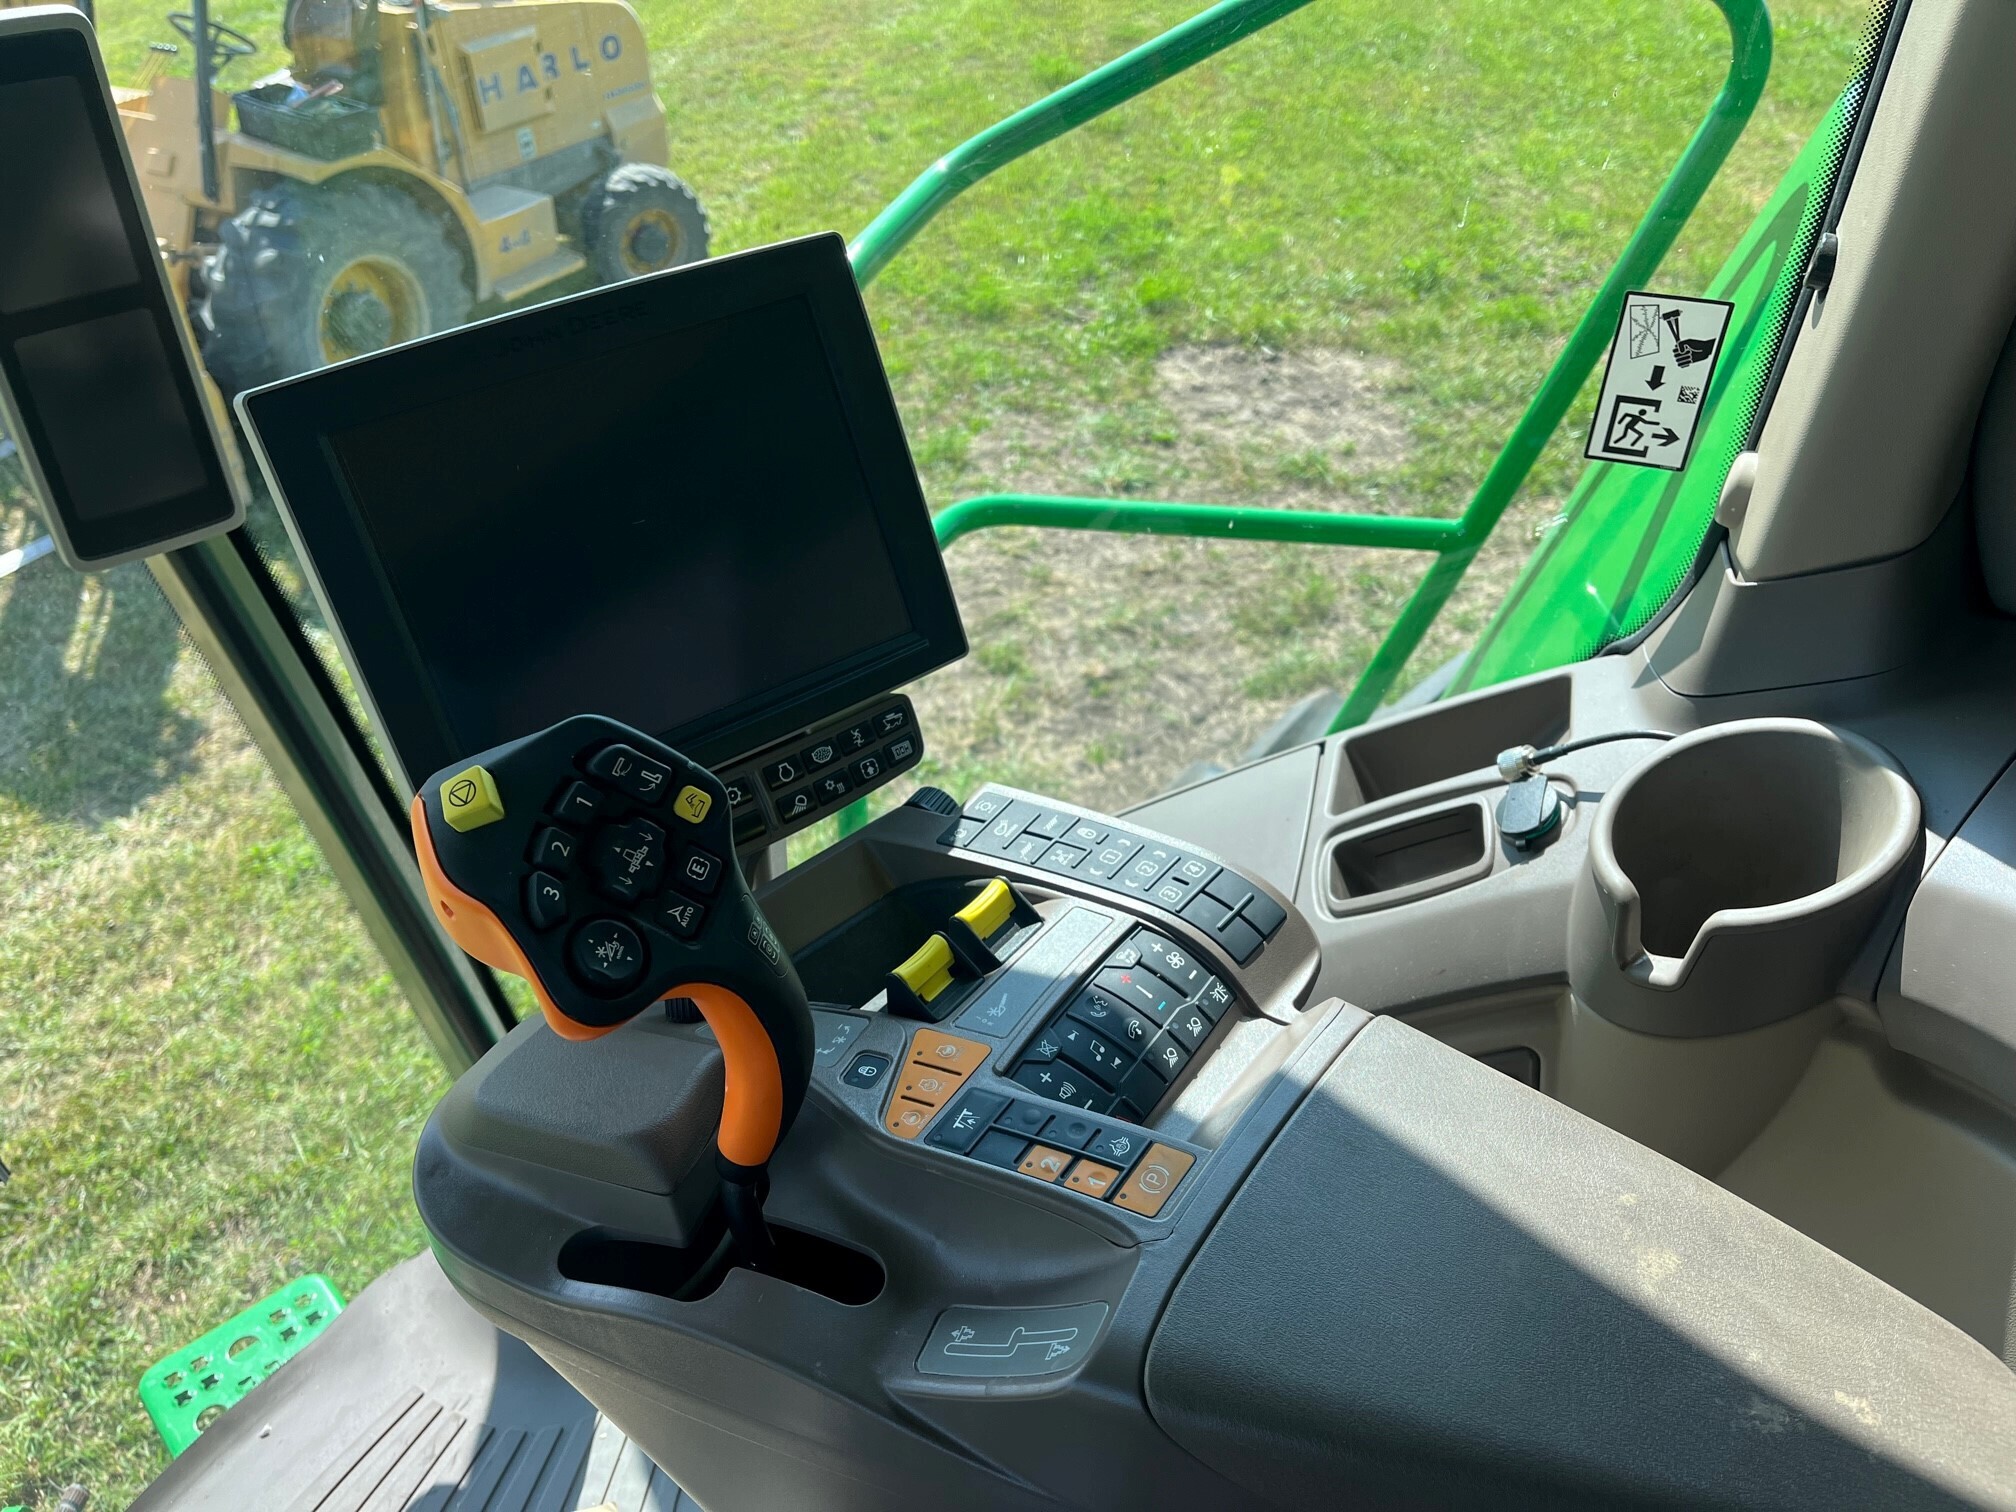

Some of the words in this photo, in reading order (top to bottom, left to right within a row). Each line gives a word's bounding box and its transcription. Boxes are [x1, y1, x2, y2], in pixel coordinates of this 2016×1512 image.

[480, 34, 621, 105] HARLO
[576, 796, 593, 807] 1
[551, 841, 570, 857] 2
[691, 864, 705, 874] E
[1142, 864, 1153, 873] 2
[1188, 864, 1200, 873] 4
[543, 886, 560, 901] 3
[1163, 889, 1176, 898] 3
[680, 906, 694, 928] AUTO
[1040, 1158, 1061, 1173] 2
[1087, 1176, 1106, 1187] 1
[1145, 1172, 1161, 1186] P
